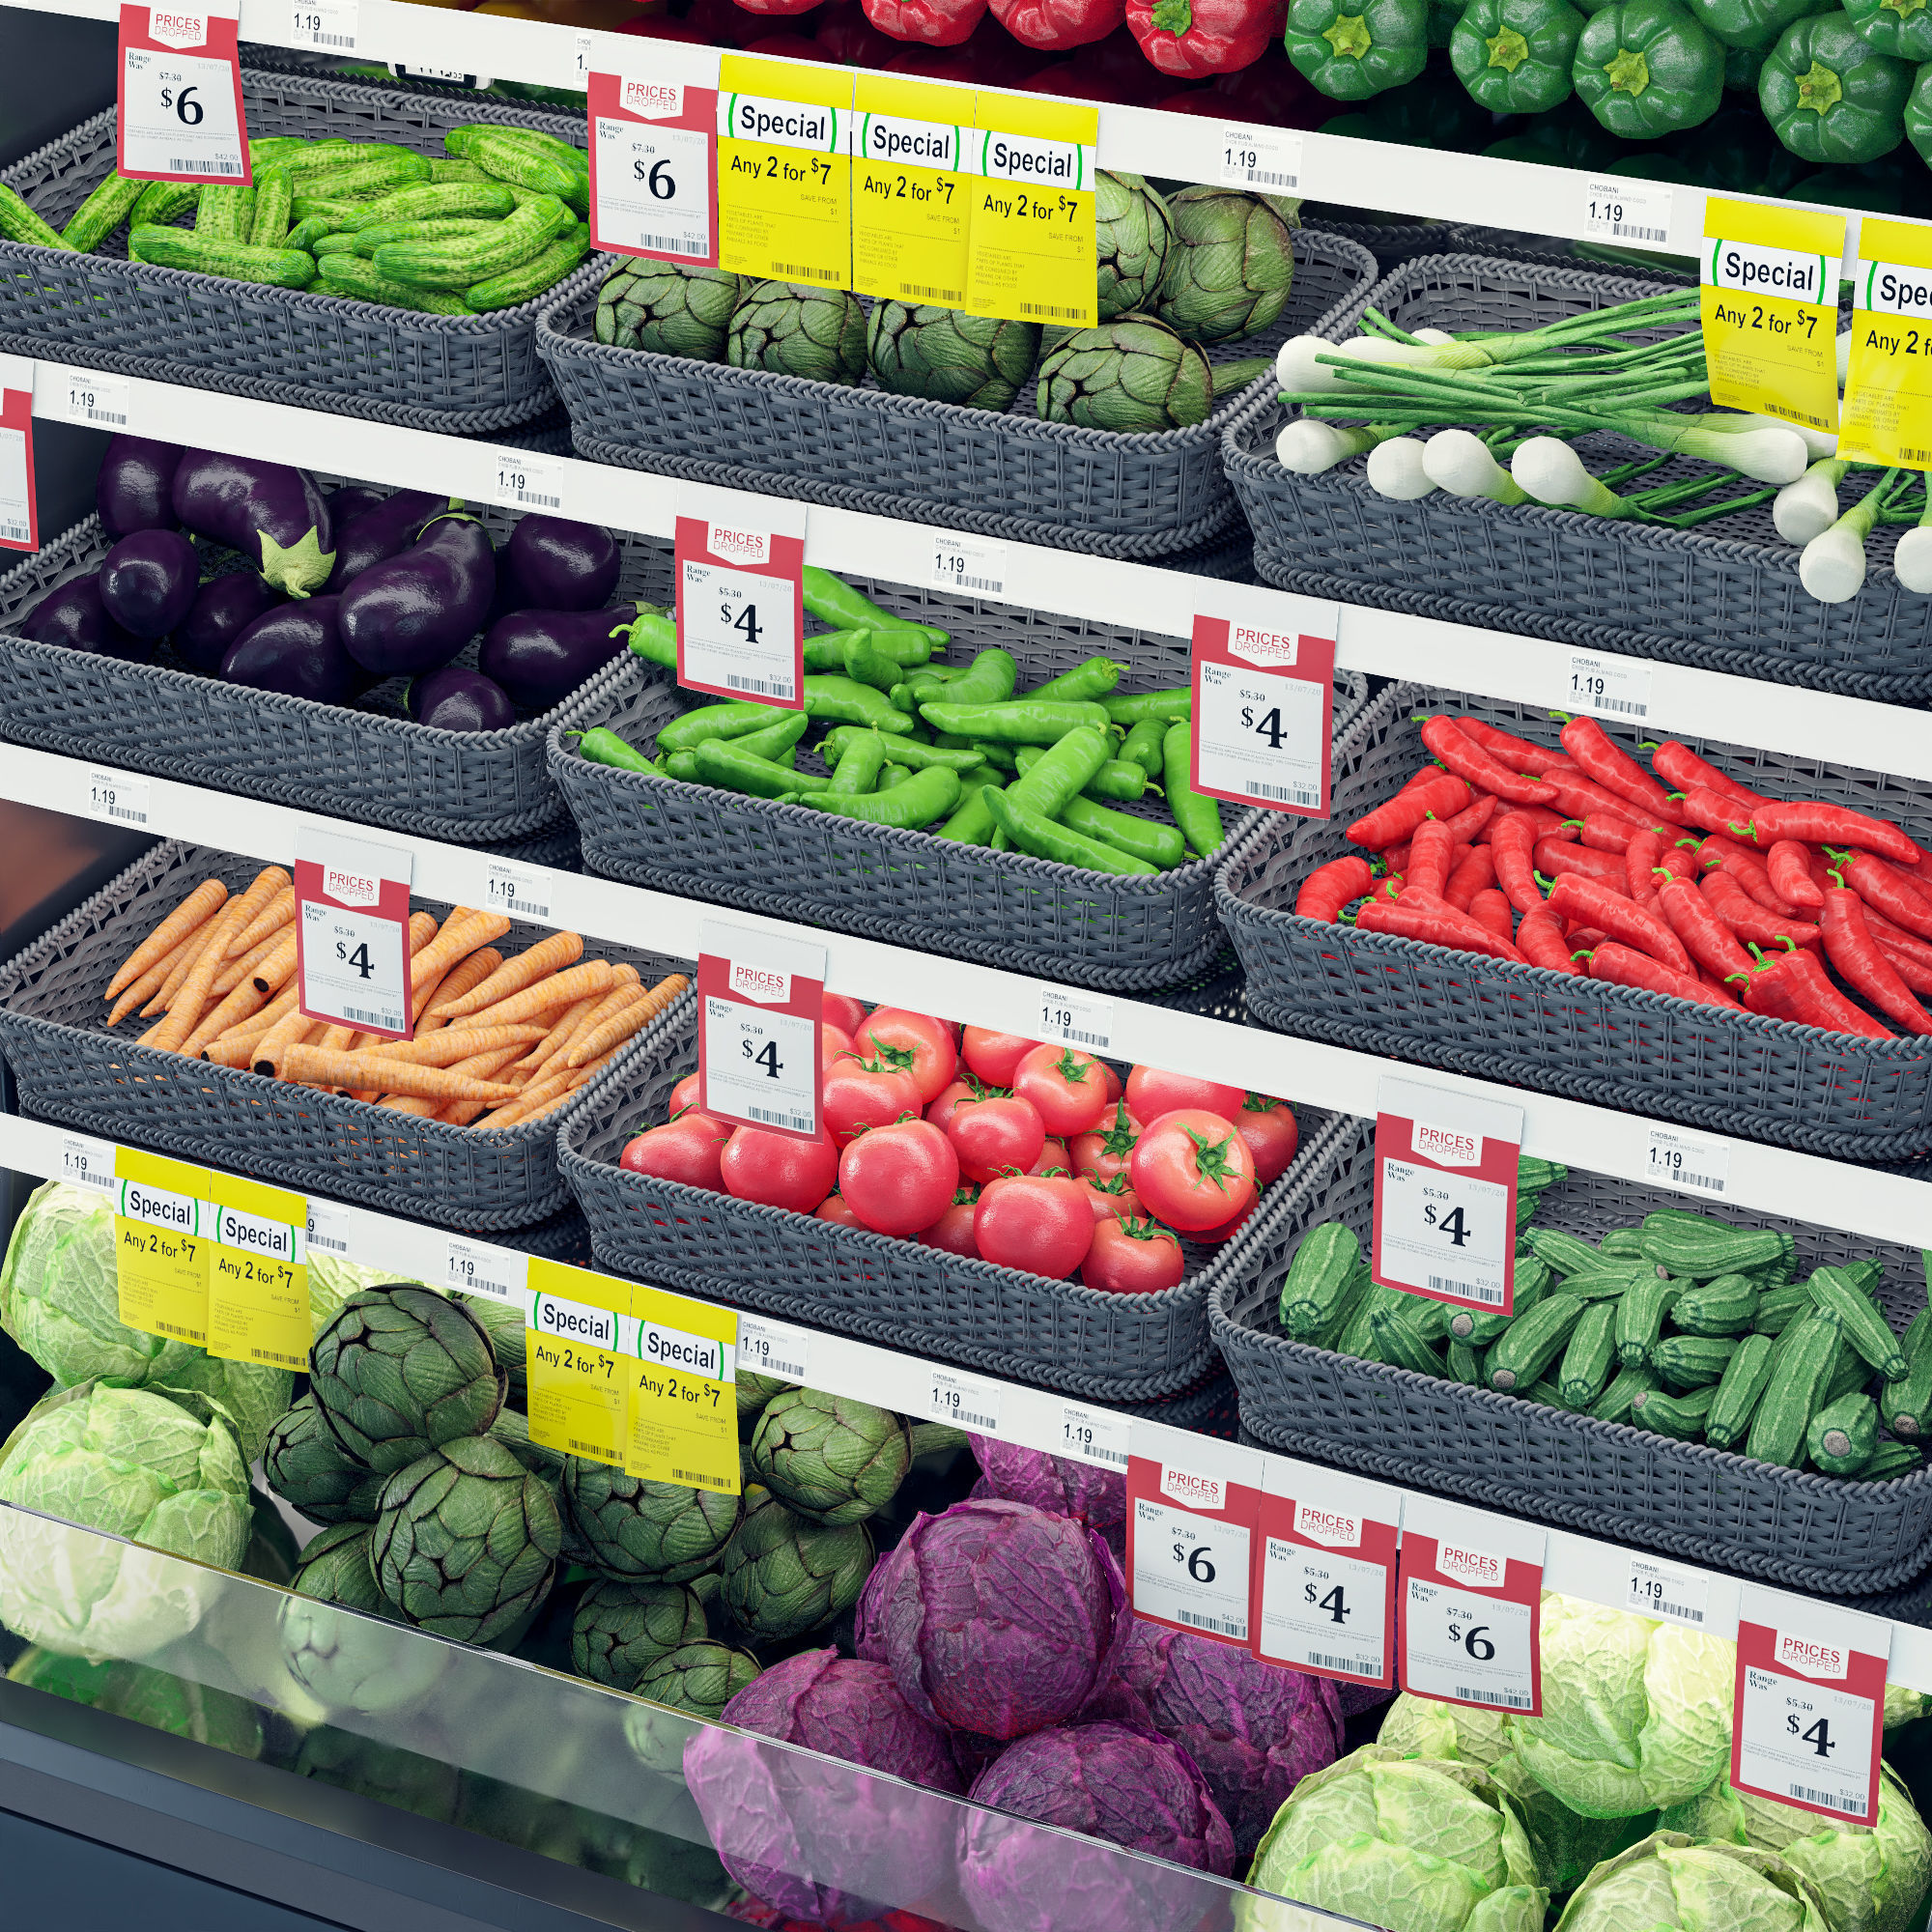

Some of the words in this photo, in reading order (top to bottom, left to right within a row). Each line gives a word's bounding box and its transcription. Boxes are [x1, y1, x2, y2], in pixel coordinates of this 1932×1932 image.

[156, 14, 201, 31] PRICES
[295, 13, 320, 30] 1.19
[155, 26, 201, 41] DROPPED
[128, 52, 151, 63] Range
[128, 61, 143, 70] Was
[628, 83, 676, 100] PRICES
[627, 95, 676, 111] DROPPED
[600, 122, 623, 133] Range
[741, 105, 825, 140] Special
[600, 130, 615, 140] Was
[873, 126, 950, 158] Special
[1226, 131, 1252, 140] CHOBANI
[994, 144, 1071, 178] Special
[1226, 149, 1256, 167] 1.19
[731, 155, 760, 178] Any
[767, 156, 778, 178] 2
[783, 162, 806, 182] for
[811, 157, 832, 185] $7
[865, 176, 891, 199] Any
[896, 176, 906, 198] 2
[912, 183, 931, 202] for
[937, 177, 954, 205] $7
[1590, 185, 1618, 193] CHOBANI
[983, 194, 1012, 217] Any
[1017, 194, 1027, 216] 2
[1033, 201, 1053, 220] for
[1059, 195, 1077, 223] $7
[1589, 202, 1622, 221] 1.19
[1725, 252, 1813, 290] Special
[1715, 304, 1746, 329] Any
[1751, 306, 1763, 328] 2
[1769, 315, 1791, 334] for
[1798, 310, 1817, 338] $7
[1866, 330, 1900, 355] Any
[1906, 330, 1918, 354] 2
[70, 390, 95, 407] 1.19
[498, 471, 525, 489] 1.19
[715, 528, 763, 548] PRICES
[713, 541, 763, 558] DROPPED
[687, 565, 711, 577] Range
[936, 554, 964, 573] 1.19
[687, 574, 702, 583] Was
[1236, 628, 1290, 649] PRICES
[1235, 640, 1291, 660] DROPPED
[1573, 657, 1600, 668] CHOBANI
[1205, 667, 1231, 679] Range
[1205, 674, 1222, 685] Was
[1572, 674, 1604, 695] 1.19
[92, 787, 115, 804] 1.19
[329, 871, 374, 891] PRICES
[490, 879, 514, 896] 1.19
[328, 883, 374, 901] DROPPED
[305, 904, 327, 916] Range
[305, 912, 320, 922] Was
[736, 967, 783, 987] PRICES
[735, 979, 784, 997] DROPPED
[1043, 991, 1067, 1001] CHOBANI
[709, 1000, 732, 1012] Range
[709, 1009, 725, 1018] Was
[1043, 1007, 1070, 1026] 1.19
[1420, 1127, 1474, 1150] PRICES
[1651, 1131, 1678, 1141] CHOBANI
[1419, 1140, 1474, 1160] DROPPED
[1650, 1148, 1682, 1168] 1.19
[64, 1152, 87, 1171] 1.19
[1388, 1162, 1414, 1176] Range
[1388, 1172, 1406, 1182] Was
[130, 1190, 190, 1225] Special
[226, 1217, 287, 1252] Special
[125, 1232, 145, 1252] Any
[150, 1235, 156, 1252] 2
[162, 1242, 178, 1258] for
[182, 1238, 195, 1262] $7
[219, 1259, 241, 1280] Any
[245, 1262, 253, 1279] 2
[257, 1269, 274, 1285] for
[278, 1265, 293, 1289] $7
[449, 1257, 473, 1275] 1.19
[544, 1304, 609, 1341] Special
[647, 1332, 714, 1370] Special
[743, 1337, 769, 1355] 1.19
[536, 1346, 559, 1367] Any
[564, 1350, 572, 1368] 2
[578, 1359, 594, 1375] for
[599, 1354, 613, 1378] $7
[639, 1375, 664, 1397] Any
[668, 1378, 677, 1398] 2
[682, 1387, 699, 1404] for
[704, 1383, 720, 1406] $7
[933, 1388, 959, 1407] 1.19
[710, 1415, 725, 1424] FROM
[1065, 1408, 1089, 1419] CHOBANI
[1065, 1424, 1092, 1442] 1.19
[1168, 1471, 1218, 1493] PRICES
[1167, 1483, 1219, 1503] DROPPED
[1139, 1503, 1164, 1516] Range
[1139, 1511, 1155, 1521] Was
[1302, 1508, 1353, 1531] PRICES
[1300, 1520, 1354, 1541] DROPPED
[1270, 1542, 1296, 1555] Range
[1270, 1550, 1287, 1561] Was
[1444, 1548, 1497, 1571] PRICES
[1632, 1561, 1659, 1573] CHOBANI
[1443, 1559, 1498, 1581] DROPPED
[1411, 1582, 1437, 1596] Range
[1632, 1577, 1662, 1598] 1.19
[1411, 1591, 1429, 1603] Was
[1784, 1637, 1840, 1662] PRICES
[1782, 1650, 1840, 1673] DROPPED
[1749, 1671, 1777, 1685] Range
[1749, 1680, 1768, 1690] Was
